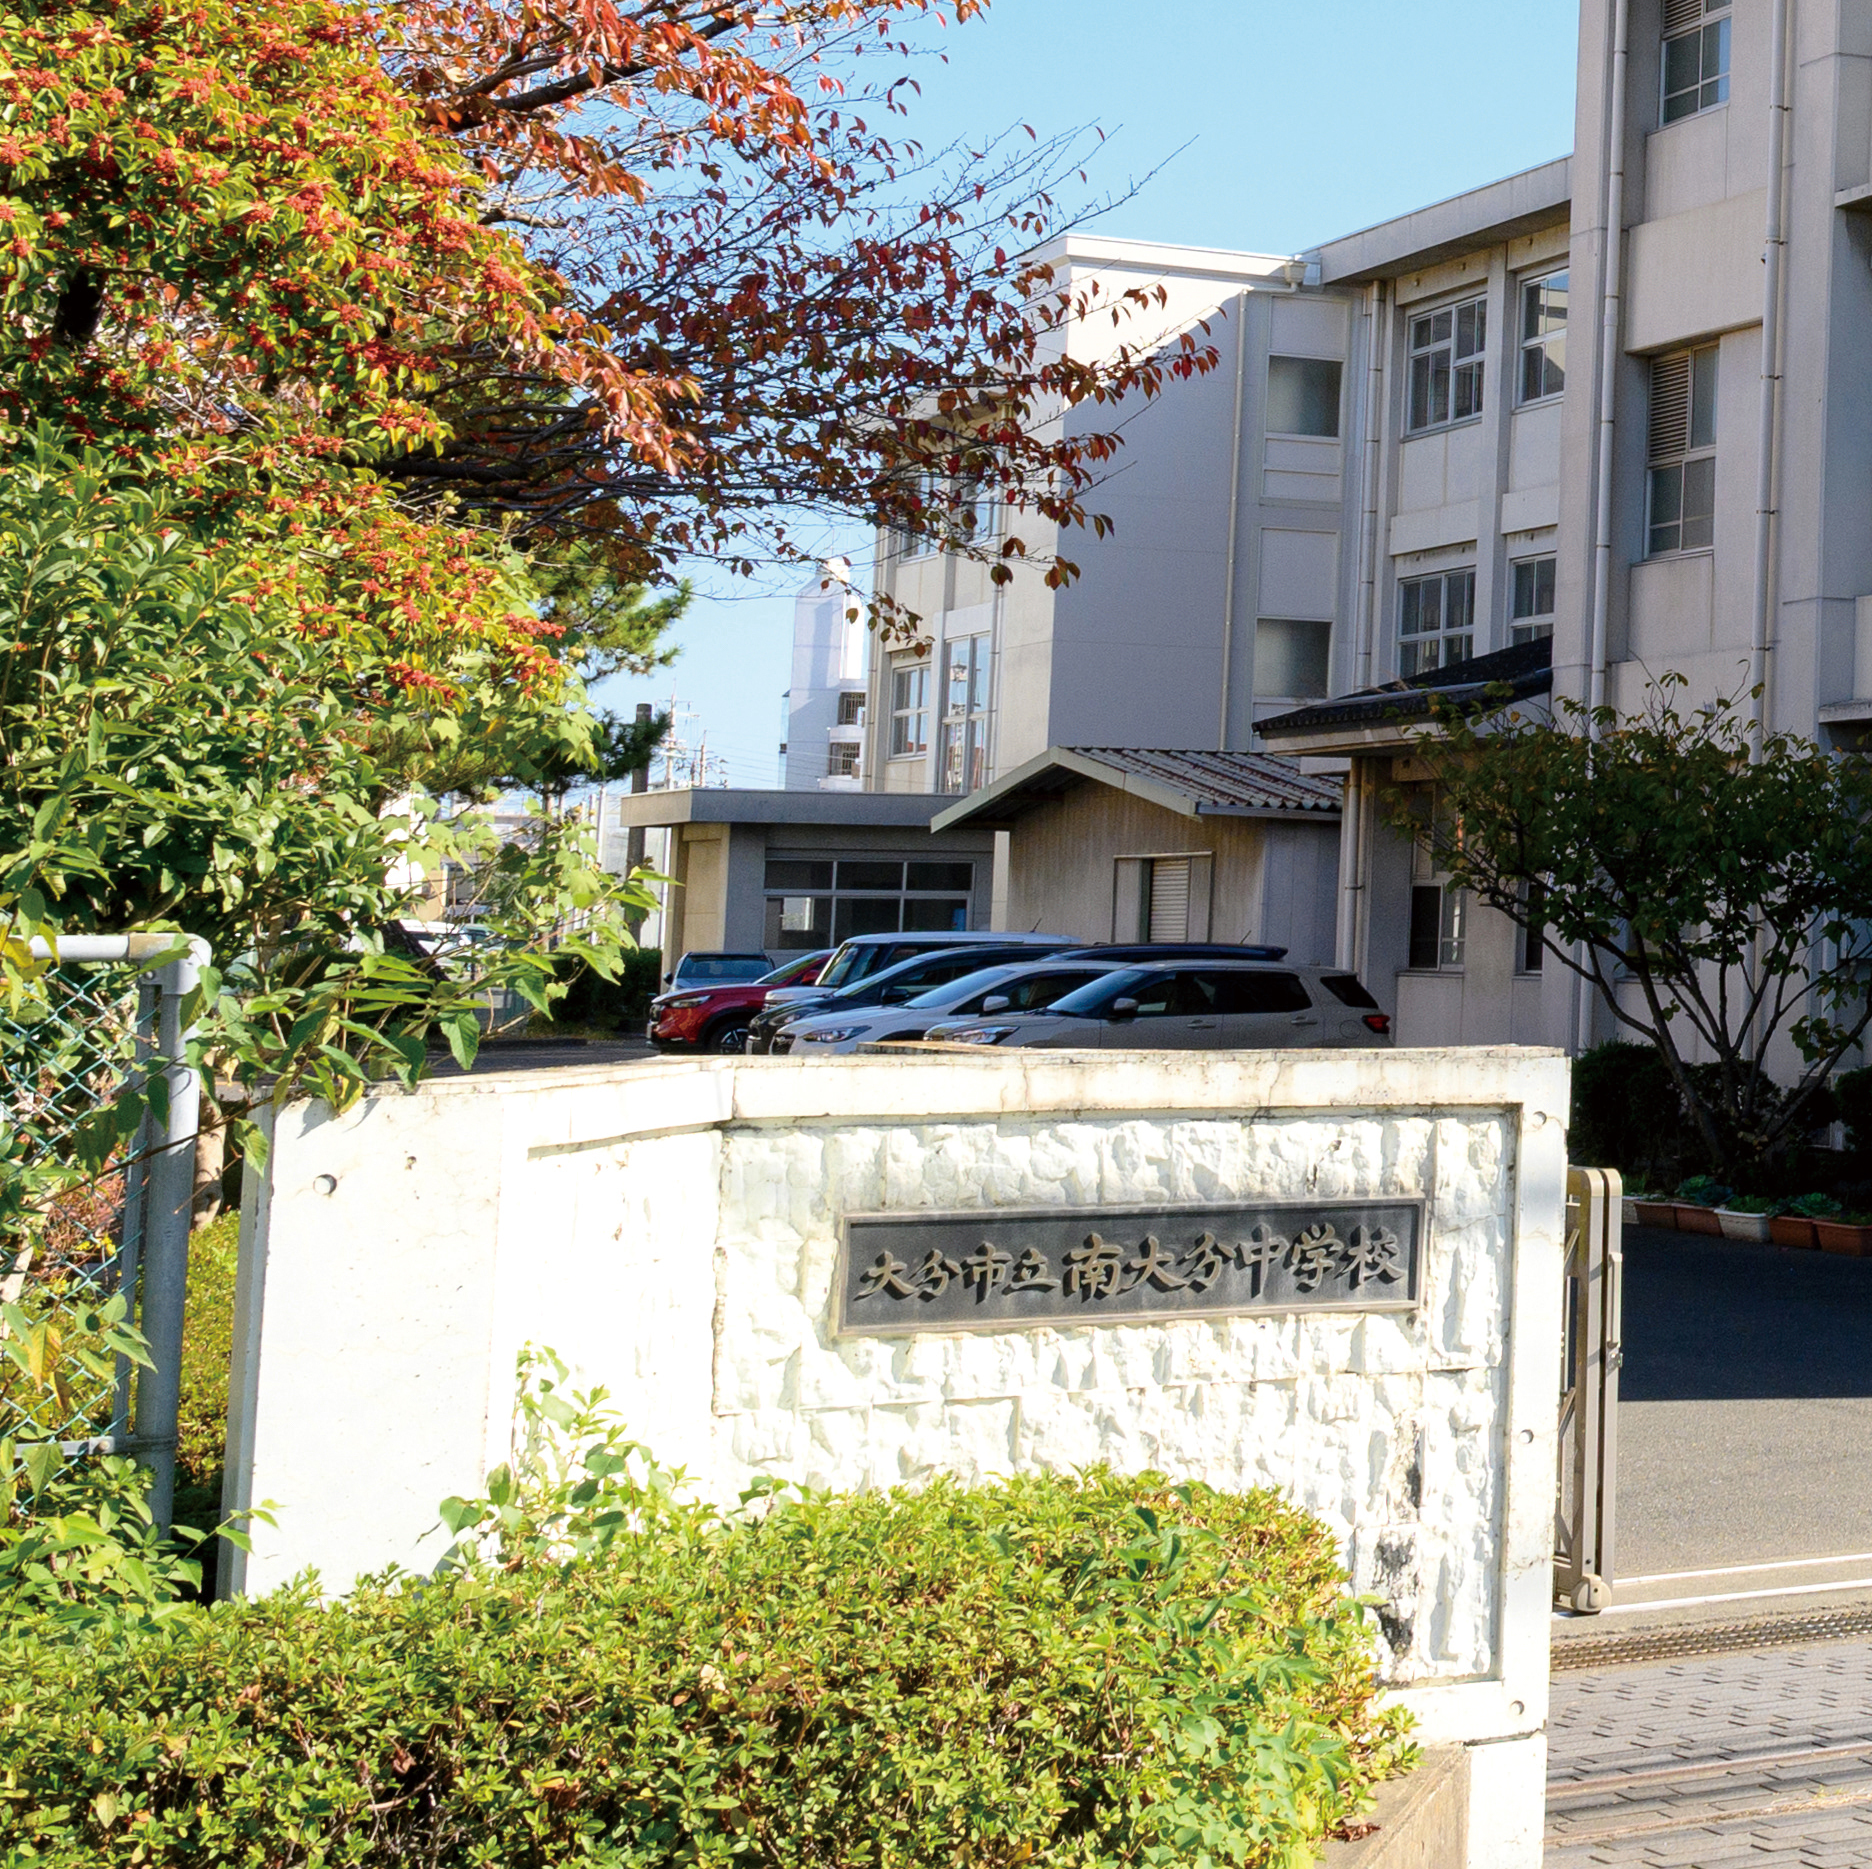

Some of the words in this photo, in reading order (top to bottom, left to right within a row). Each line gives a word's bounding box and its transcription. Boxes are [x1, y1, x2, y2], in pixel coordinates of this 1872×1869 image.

[854, 1222, 1406, 1305] 大分市立南大分中学校
